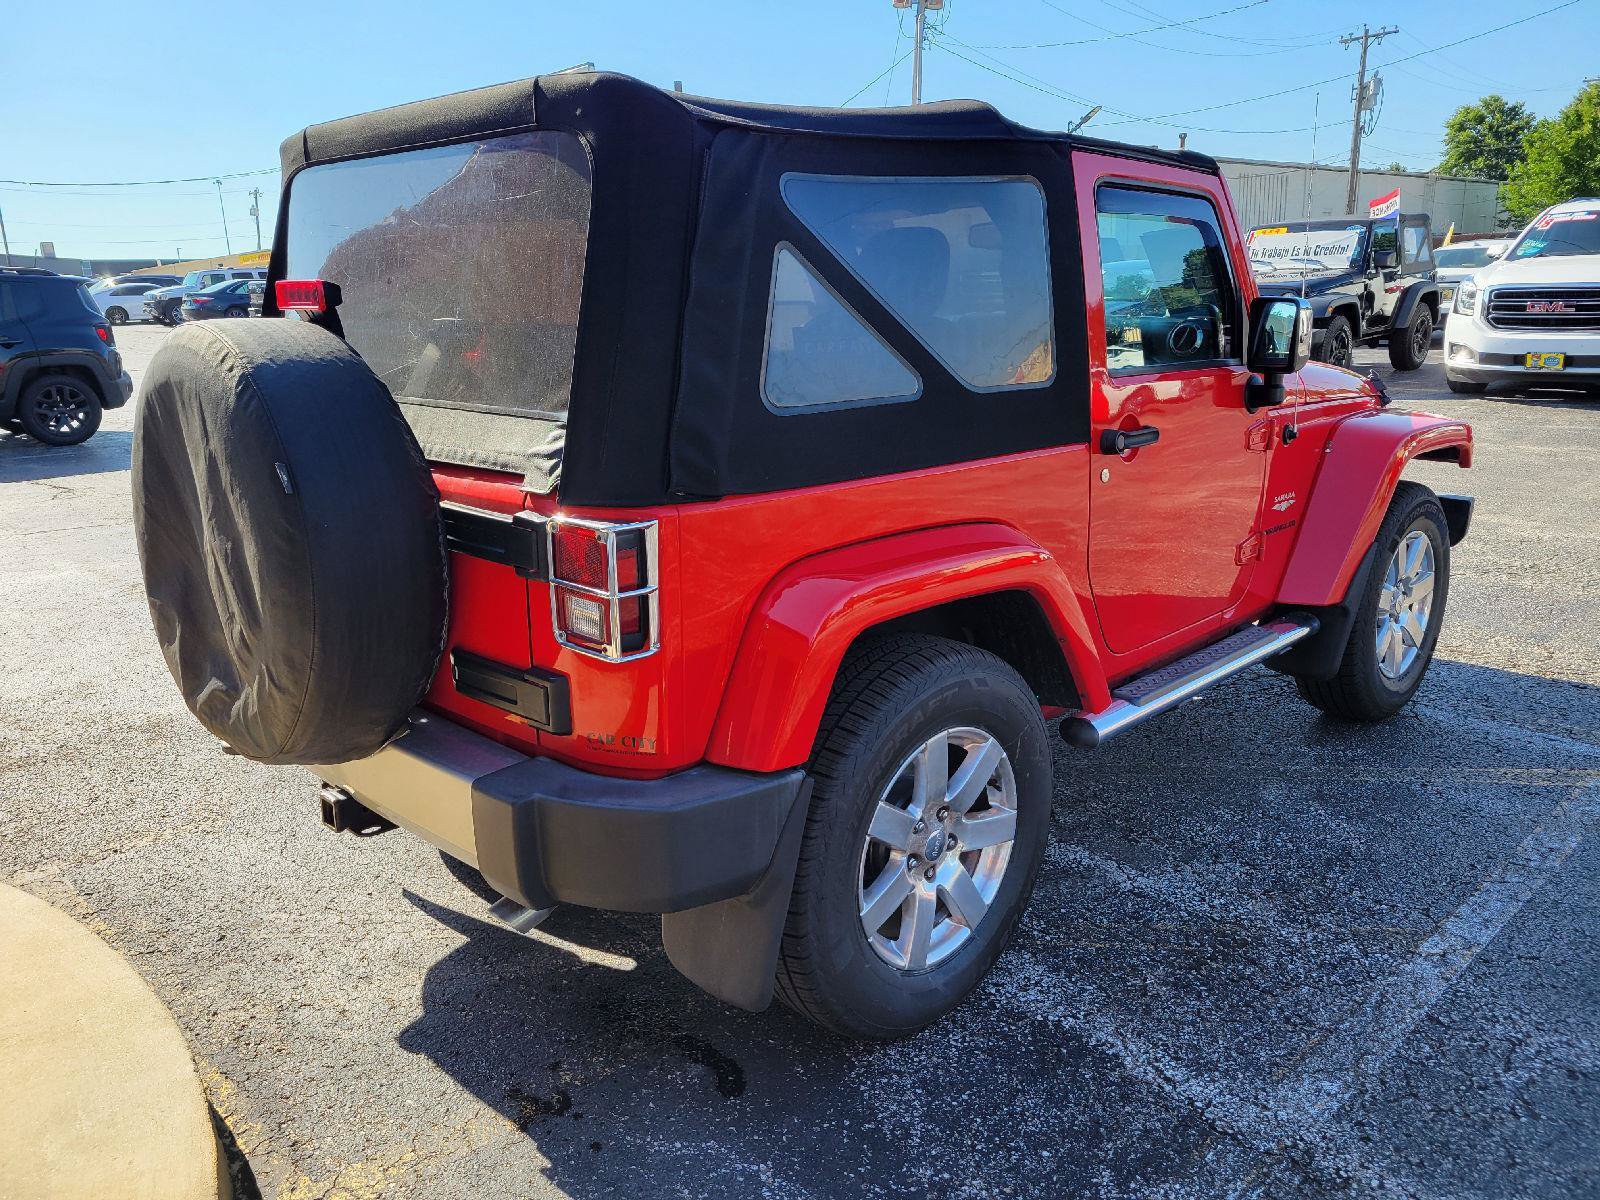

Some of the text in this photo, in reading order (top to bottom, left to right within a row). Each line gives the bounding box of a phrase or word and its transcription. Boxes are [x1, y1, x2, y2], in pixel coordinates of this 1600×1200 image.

[1260, 246, 1290, 259] Trabajo
[1291, 245, 1301, 257] Es
[1526, 301, 1576, 312] GMC
[586, 732, 657, 750] CAR CITY
